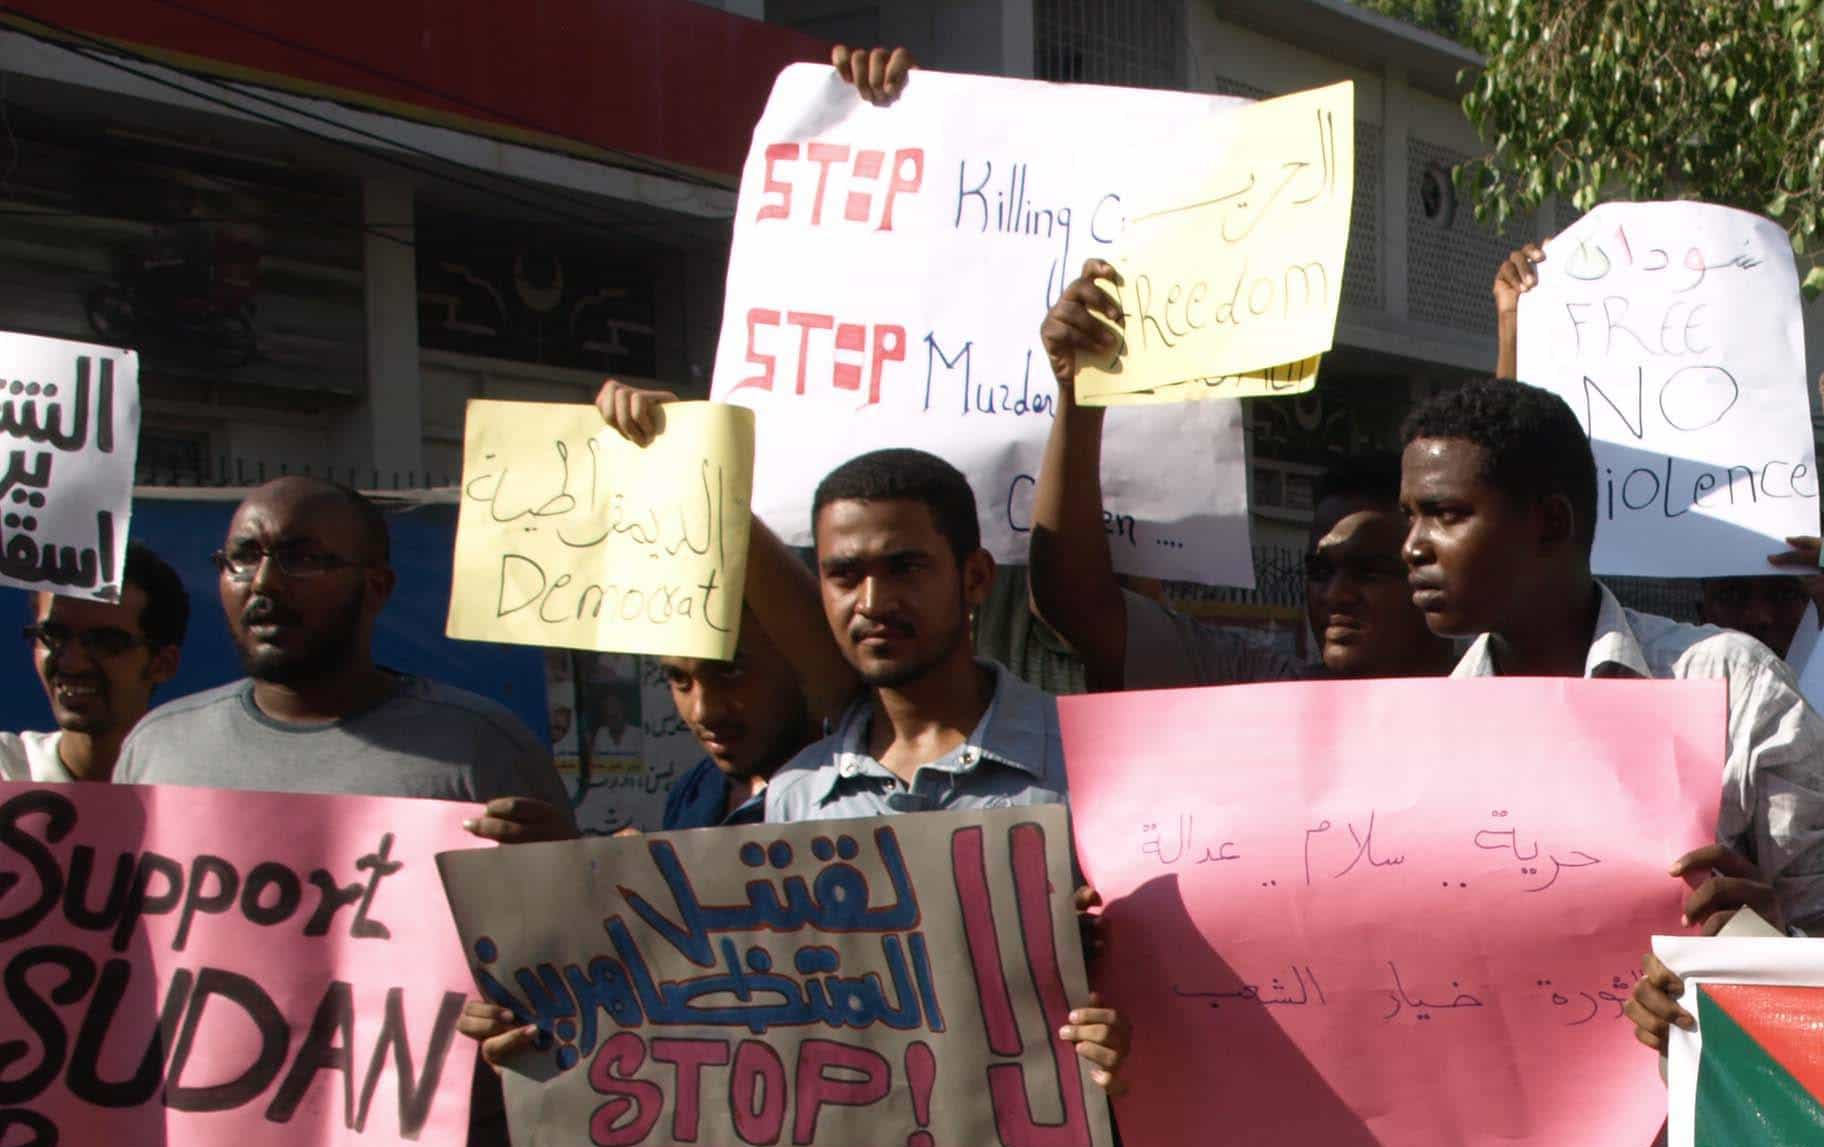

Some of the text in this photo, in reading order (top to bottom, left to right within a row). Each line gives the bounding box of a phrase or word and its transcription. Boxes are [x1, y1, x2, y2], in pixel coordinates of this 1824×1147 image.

[756, 142, 925, 232] STOP
[955, 159, 1072, 306] Killing
[724, 307, 907, 411] STOP
[1566, 295, 1714, 356] FREE
[1583, 366, 1739, 440] NO
[1606, 456, 1819, 521] iolence
[0, 789, 403, 952] Support
[1141, 809, 1601, 892] حرية سلام عدالة
[615, 825, 923, 968] لقتل
[1172, 965, 1327, 1009] الشعب
[1382, 960, 1484, 1021] خيار
[0, 945, 468, 1141] SUDAN
